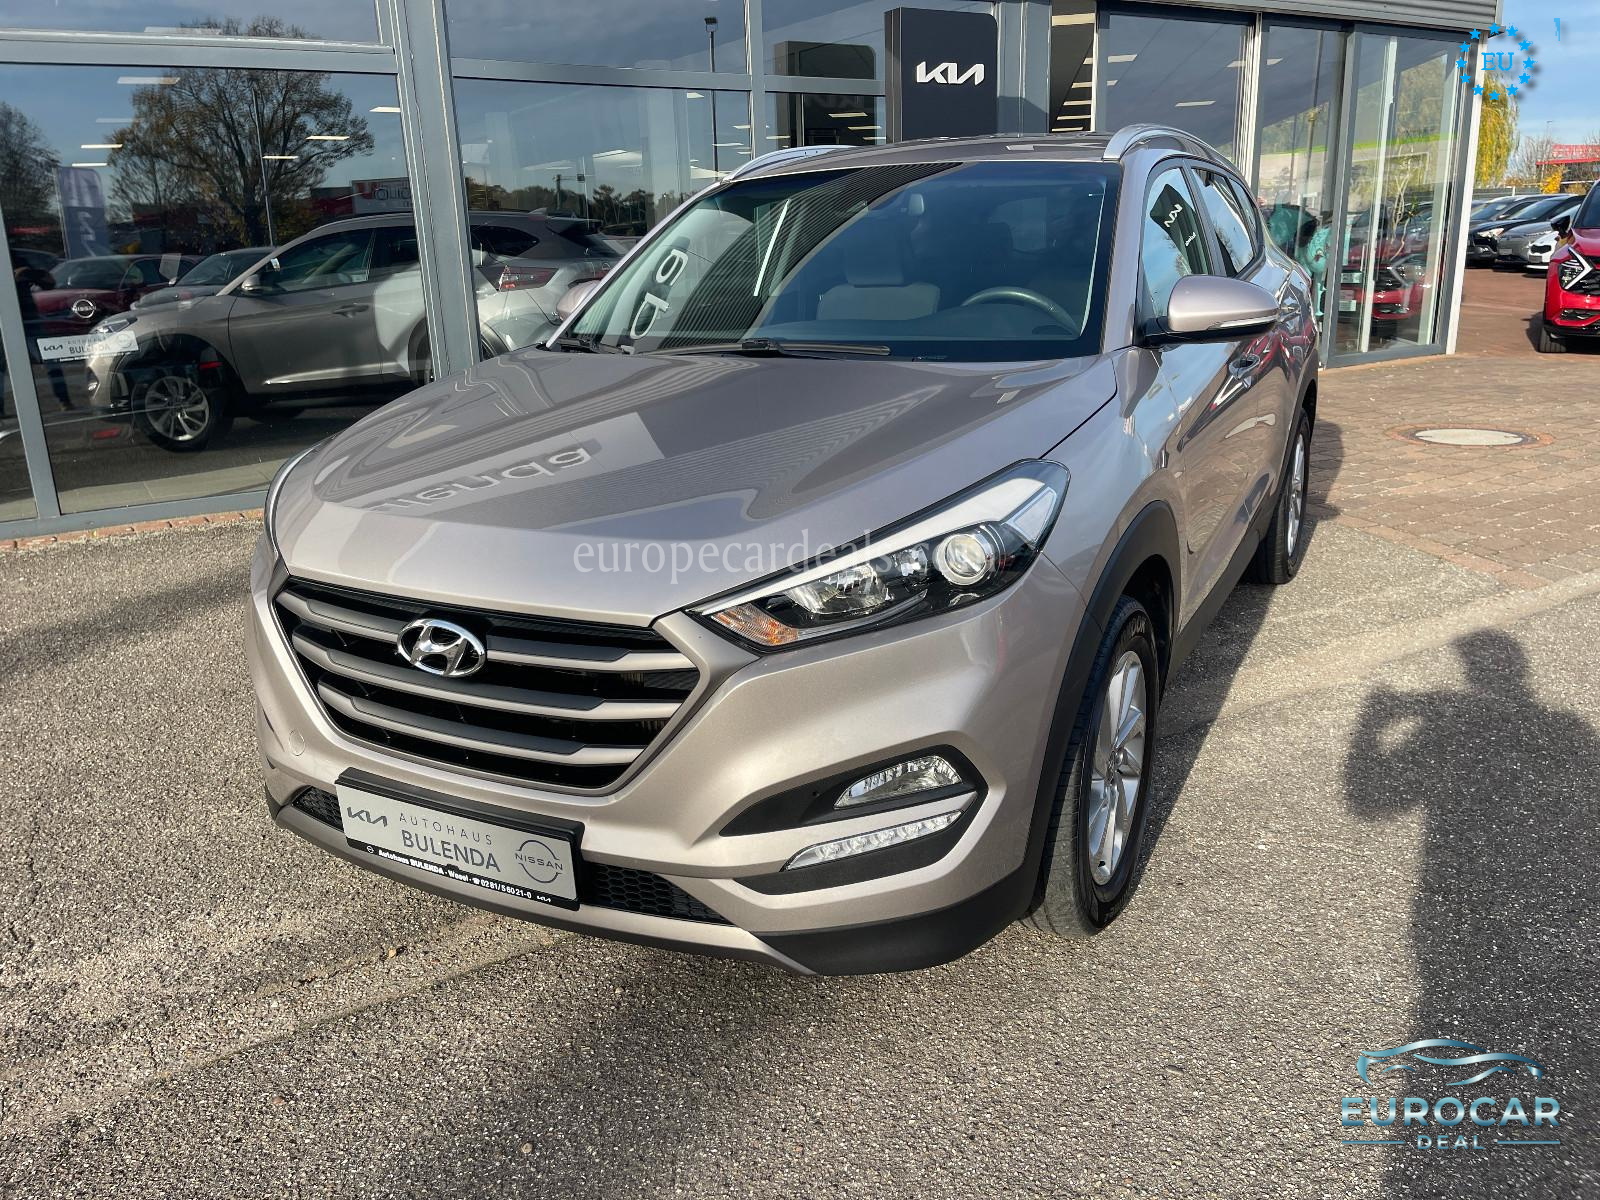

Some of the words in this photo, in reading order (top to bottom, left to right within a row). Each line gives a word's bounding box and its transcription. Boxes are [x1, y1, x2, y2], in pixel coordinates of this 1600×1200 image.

[916, 61, 985, 86] KIA
[346, 806, 388, 827] KIA
[399, 812, 494, 846] AUTOHAUS
[401, 829, 502, 873] BULENDA
[514, 852, 564, 871] NISSAN
[410, 858, 444, 876] BULENDA
